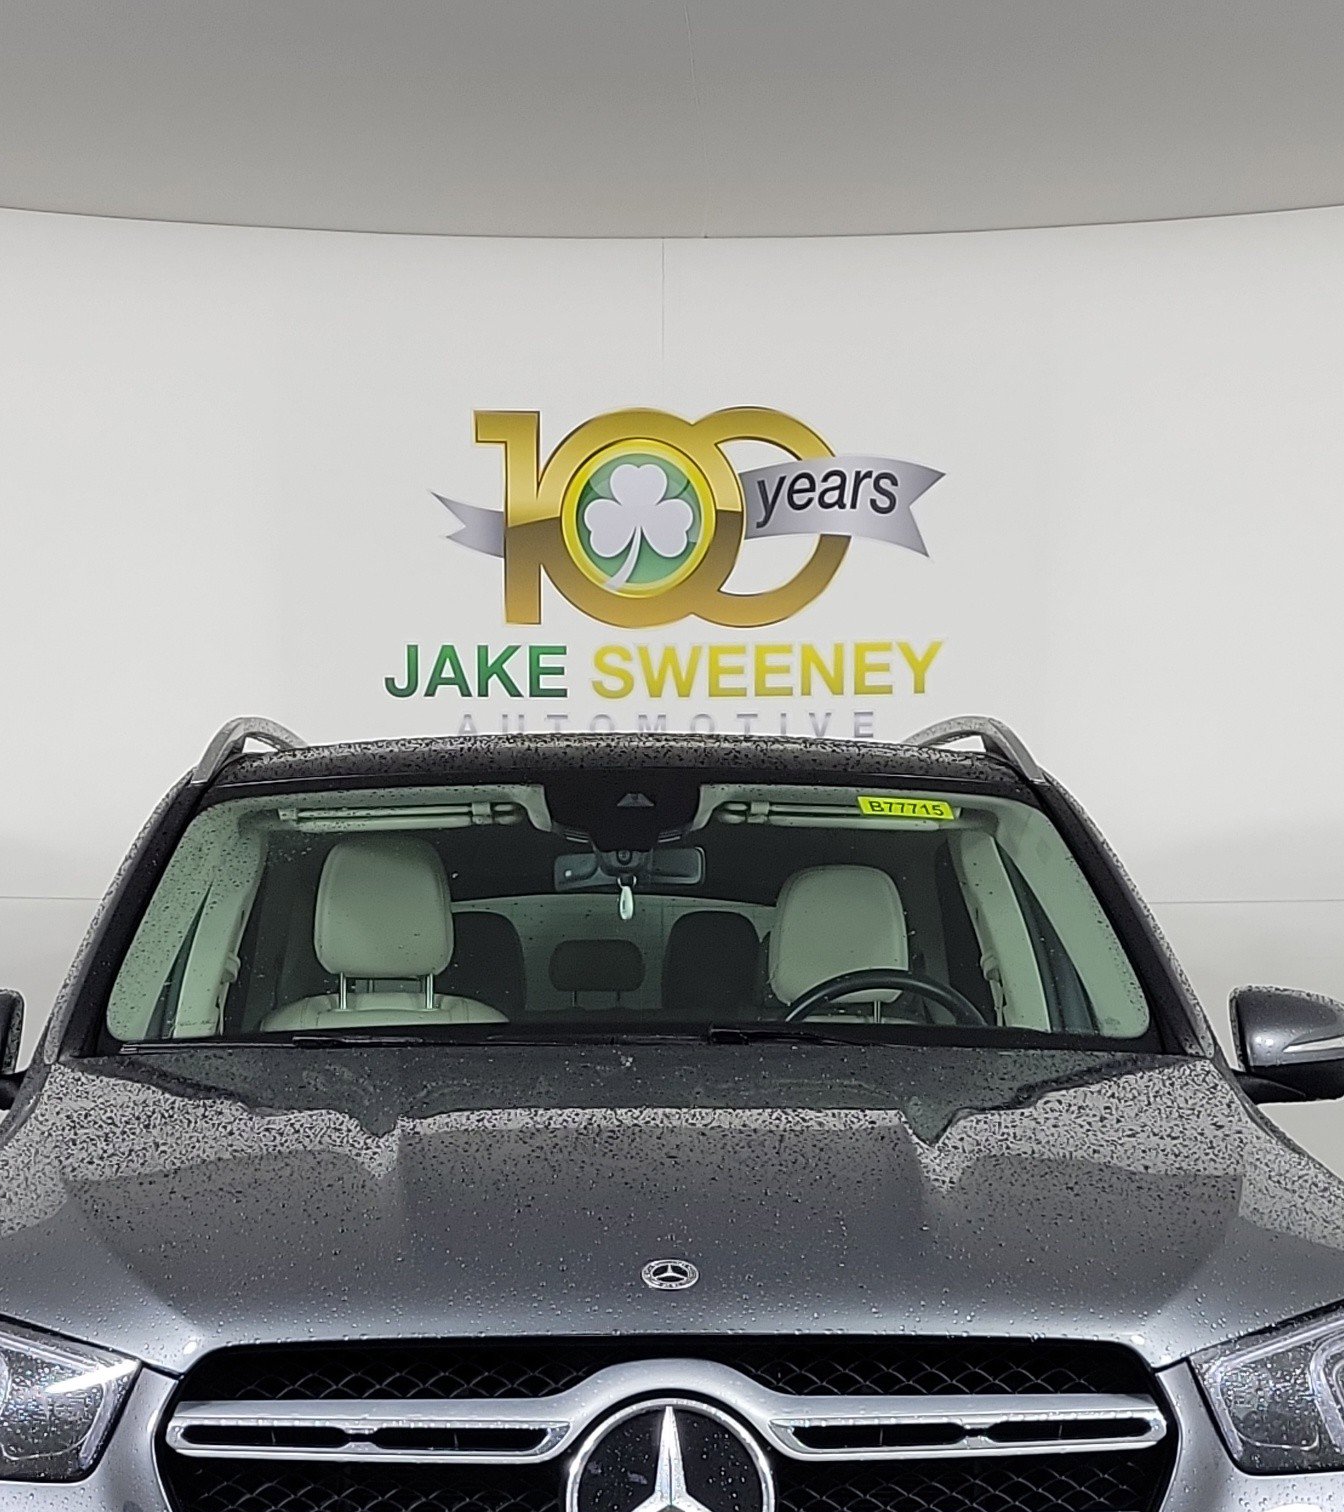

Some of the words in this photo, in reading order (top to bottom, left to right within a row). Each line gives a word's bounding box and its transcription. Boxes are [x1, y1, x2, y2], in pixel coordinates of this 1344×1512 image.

[473, 405, 851, 629] 100
[756, 470, 898, 528] years
[384, 644, 568, 698] JAKE
[591, 641, 942, 698] SWEENEY
[457, 711, 875, 738] AUTOMOTIVE
[868, 800, 945, 817] B77715
